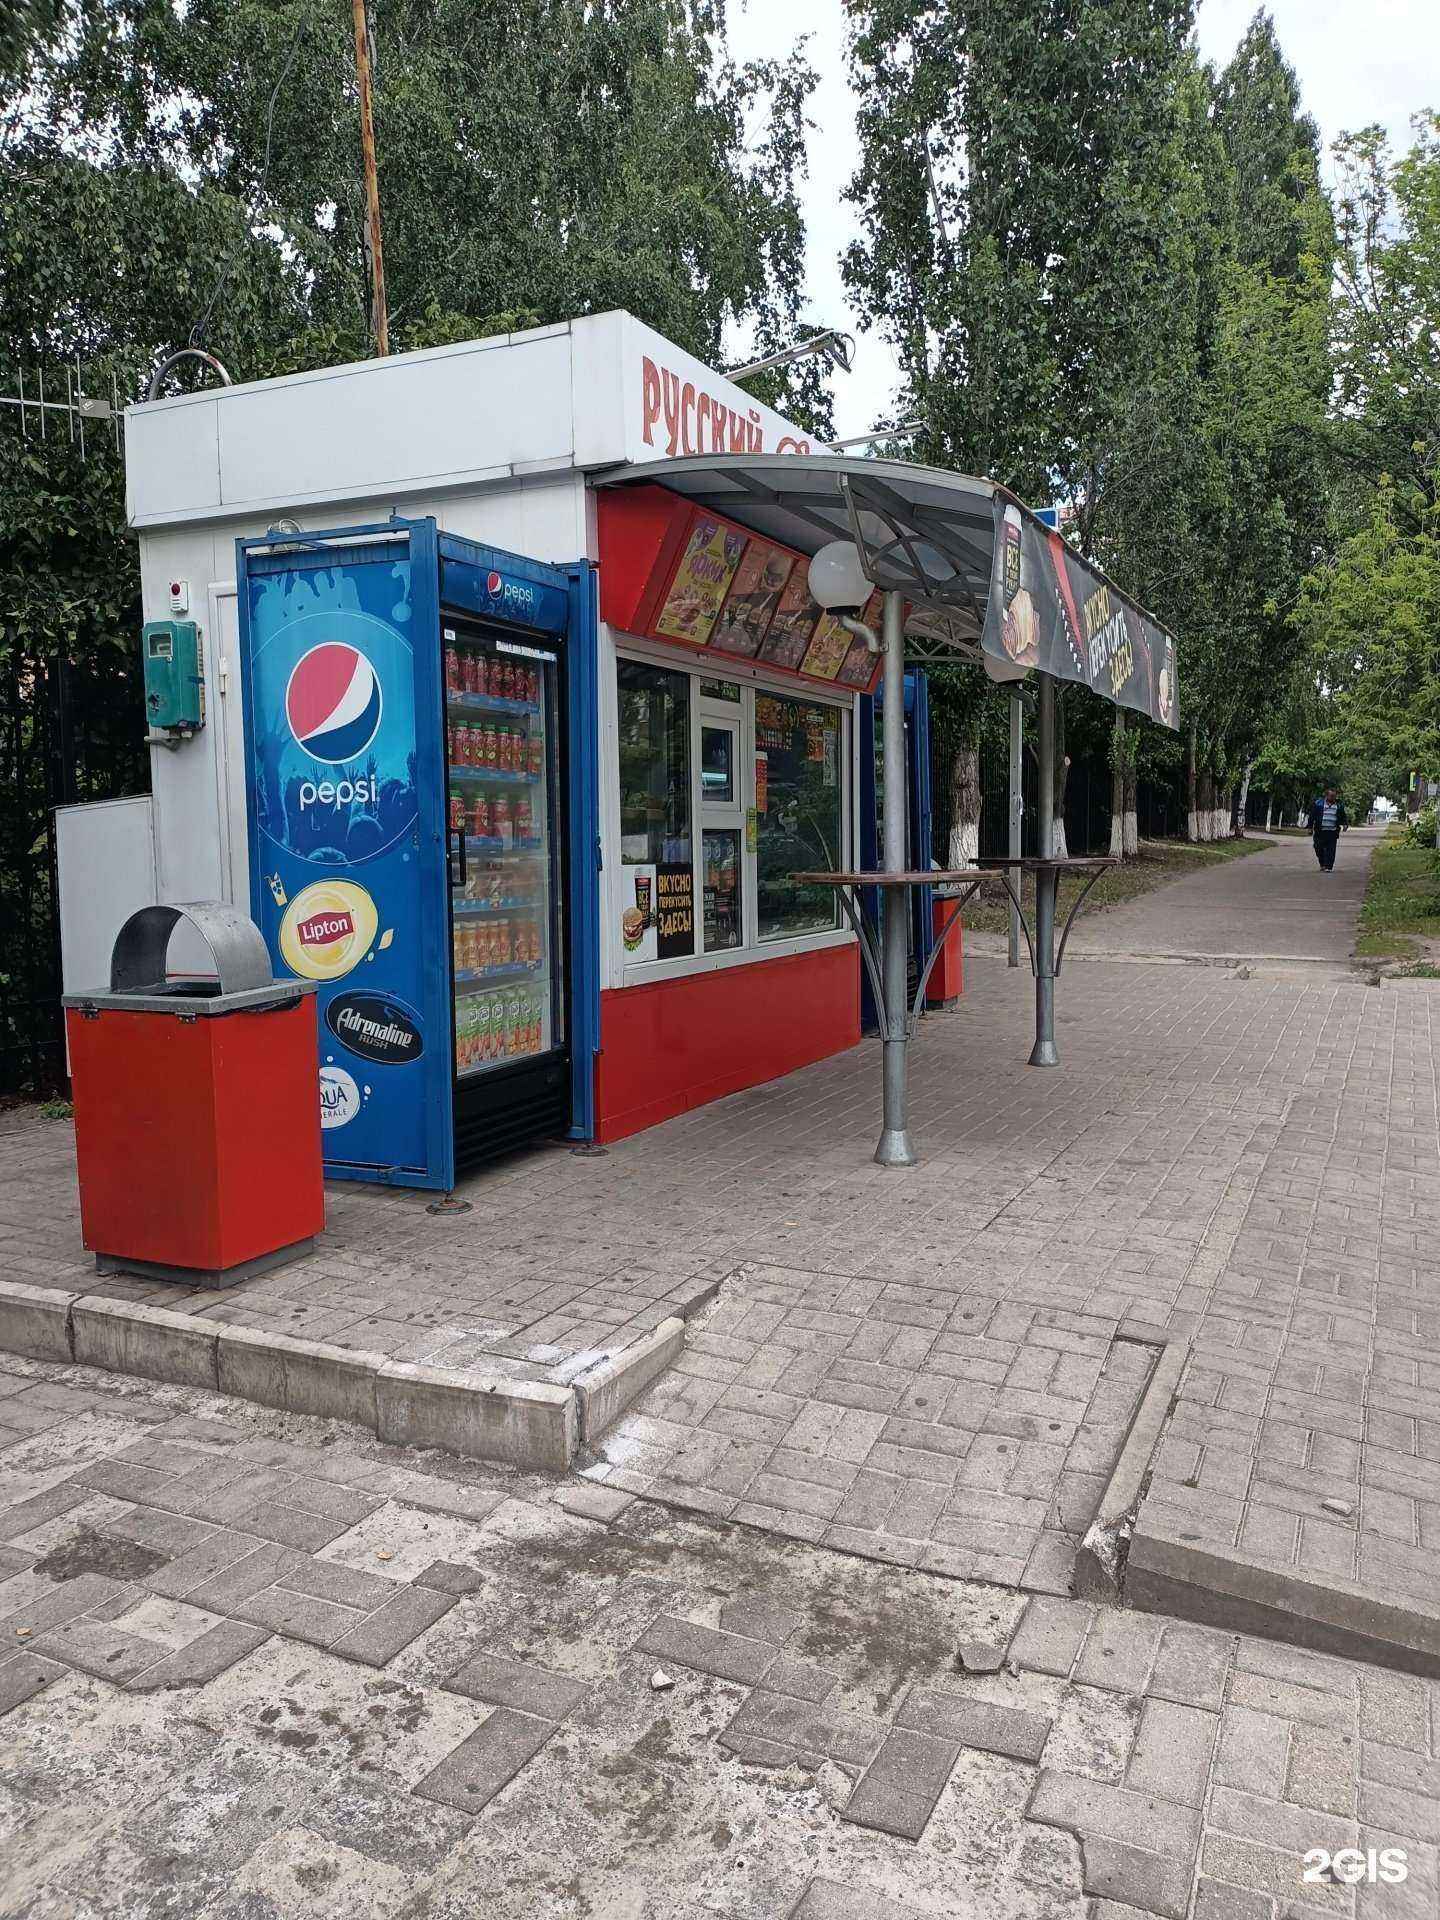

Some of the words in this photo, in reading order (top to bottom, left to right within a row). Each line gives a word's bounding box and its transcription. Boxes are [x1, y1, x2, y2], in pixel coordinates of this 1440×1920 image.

[642, 355, 763, 456] РУССКИЙ
[503, 583, 534, 602] pepsi
[300, 774, 377, 810] pepsi
[658, 874, 691, 893] ВКУСНО
[658, 895, 692, 908] ПЕРЕКУСИТЬ
[302, 917, 350, 940] Lipton
[658, 910, 692, 937] ЗДЕСЬ!
[337, 1008, 413, 1048] Adrenaline
[359, 1034, 389, 1050] RUSH
[320, 1086, 348, 1109] QUA
[320, 1108, 347, 1119] ERALE
